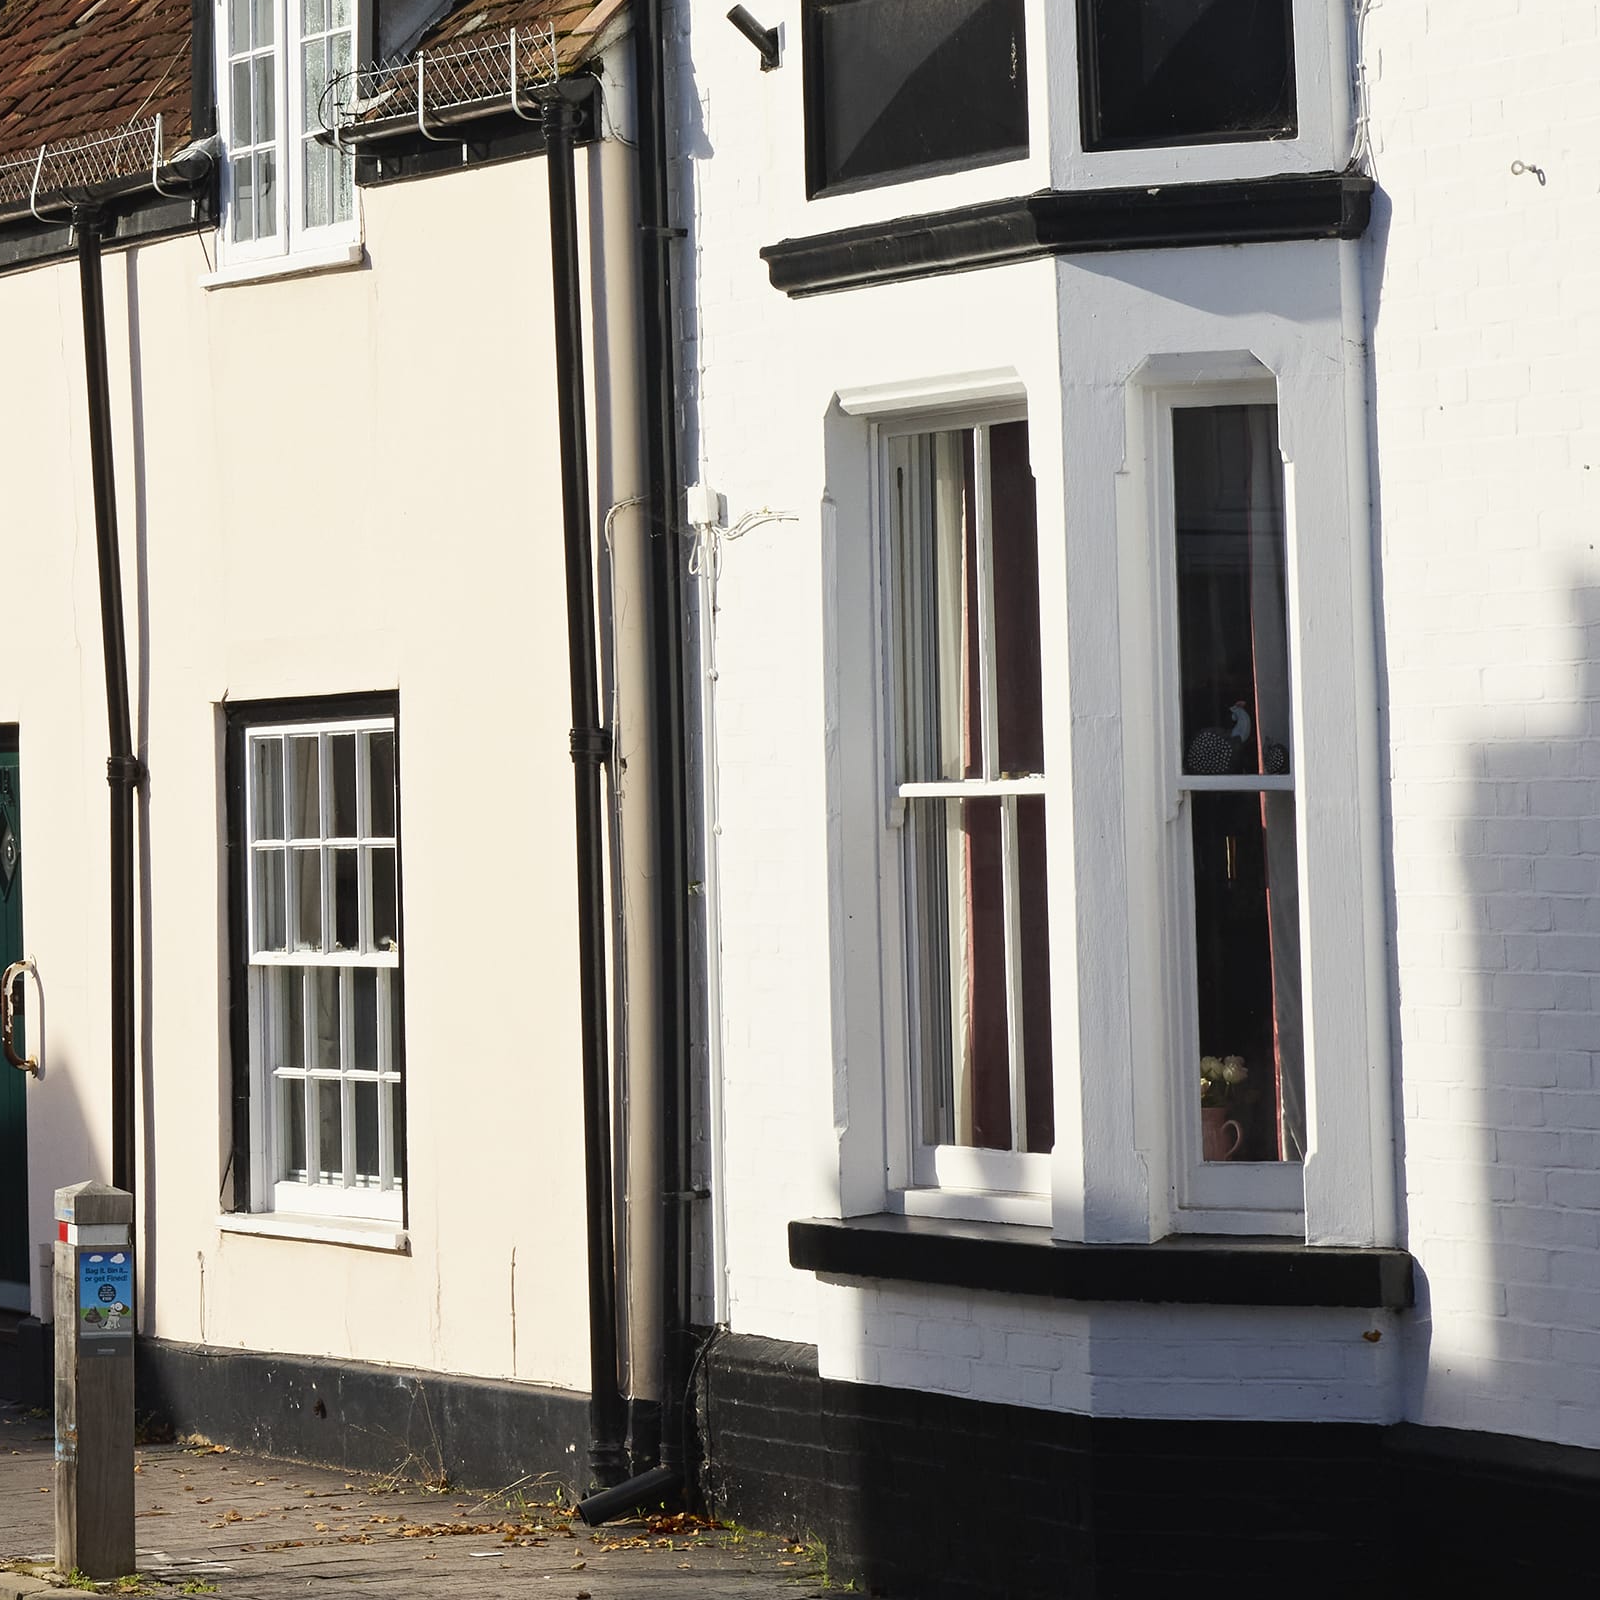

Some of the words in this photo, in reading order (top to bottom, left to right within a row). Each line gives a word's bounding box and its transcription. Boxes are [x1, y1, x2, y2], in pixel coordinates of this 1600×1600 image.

[85, 1267, 98, 1275] Bag
[93, 1275, 106, 1283] get
[107, 1274, 128, 1282] Fined!
